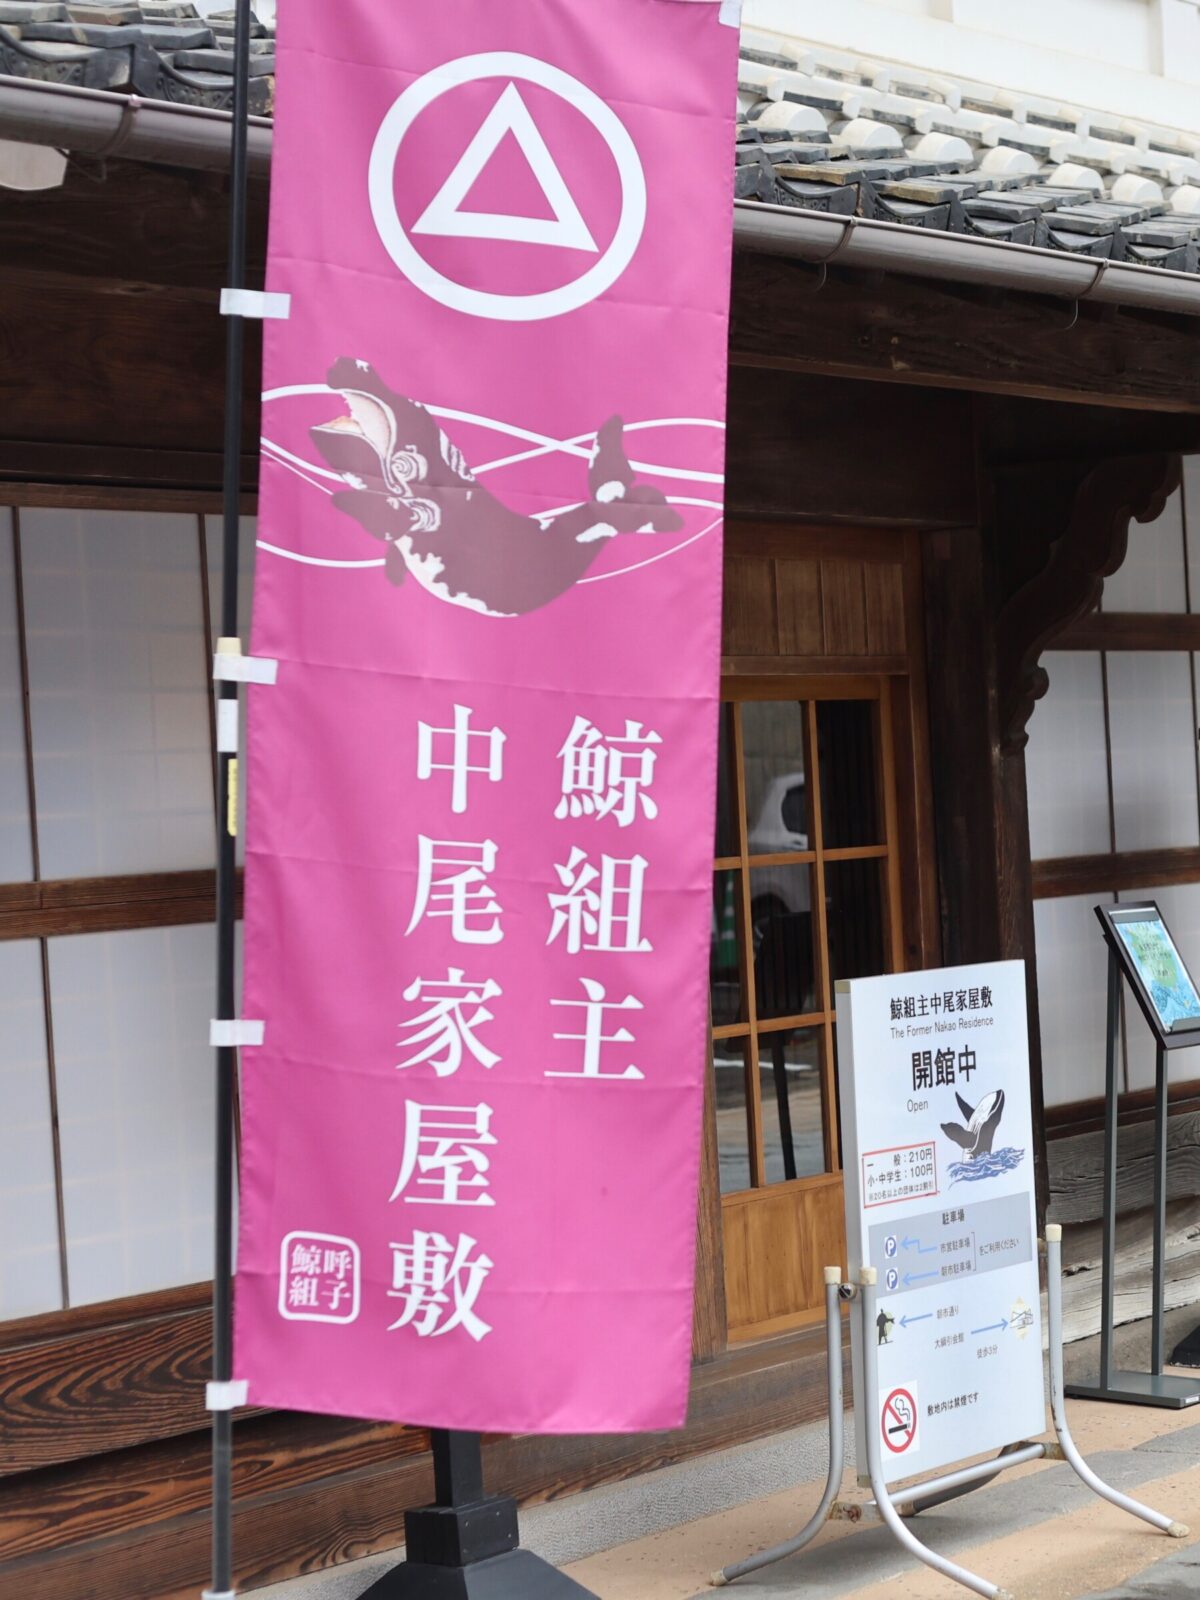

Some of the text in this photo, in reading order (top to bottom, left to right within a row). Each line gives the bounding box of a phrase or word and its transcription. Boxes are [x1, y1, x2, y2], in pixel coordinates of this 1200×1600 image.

[544, 714, 663, 1081] 鯨組主
[890, 985, 993, 1021] 鯨組主中尾家屋敷
[386, 703, 507, 1342] 中尾家屋敷
[891, 1016, 994, 1039] The Former Nakao Residence
[912, 1044, 977, 1092] 開館中
[907, 1099, 929, 1113] Open
[942, 1208, 965, 1226] 駐車場
[927, 1392, 979, 1417] 敷地内は禁煙です
